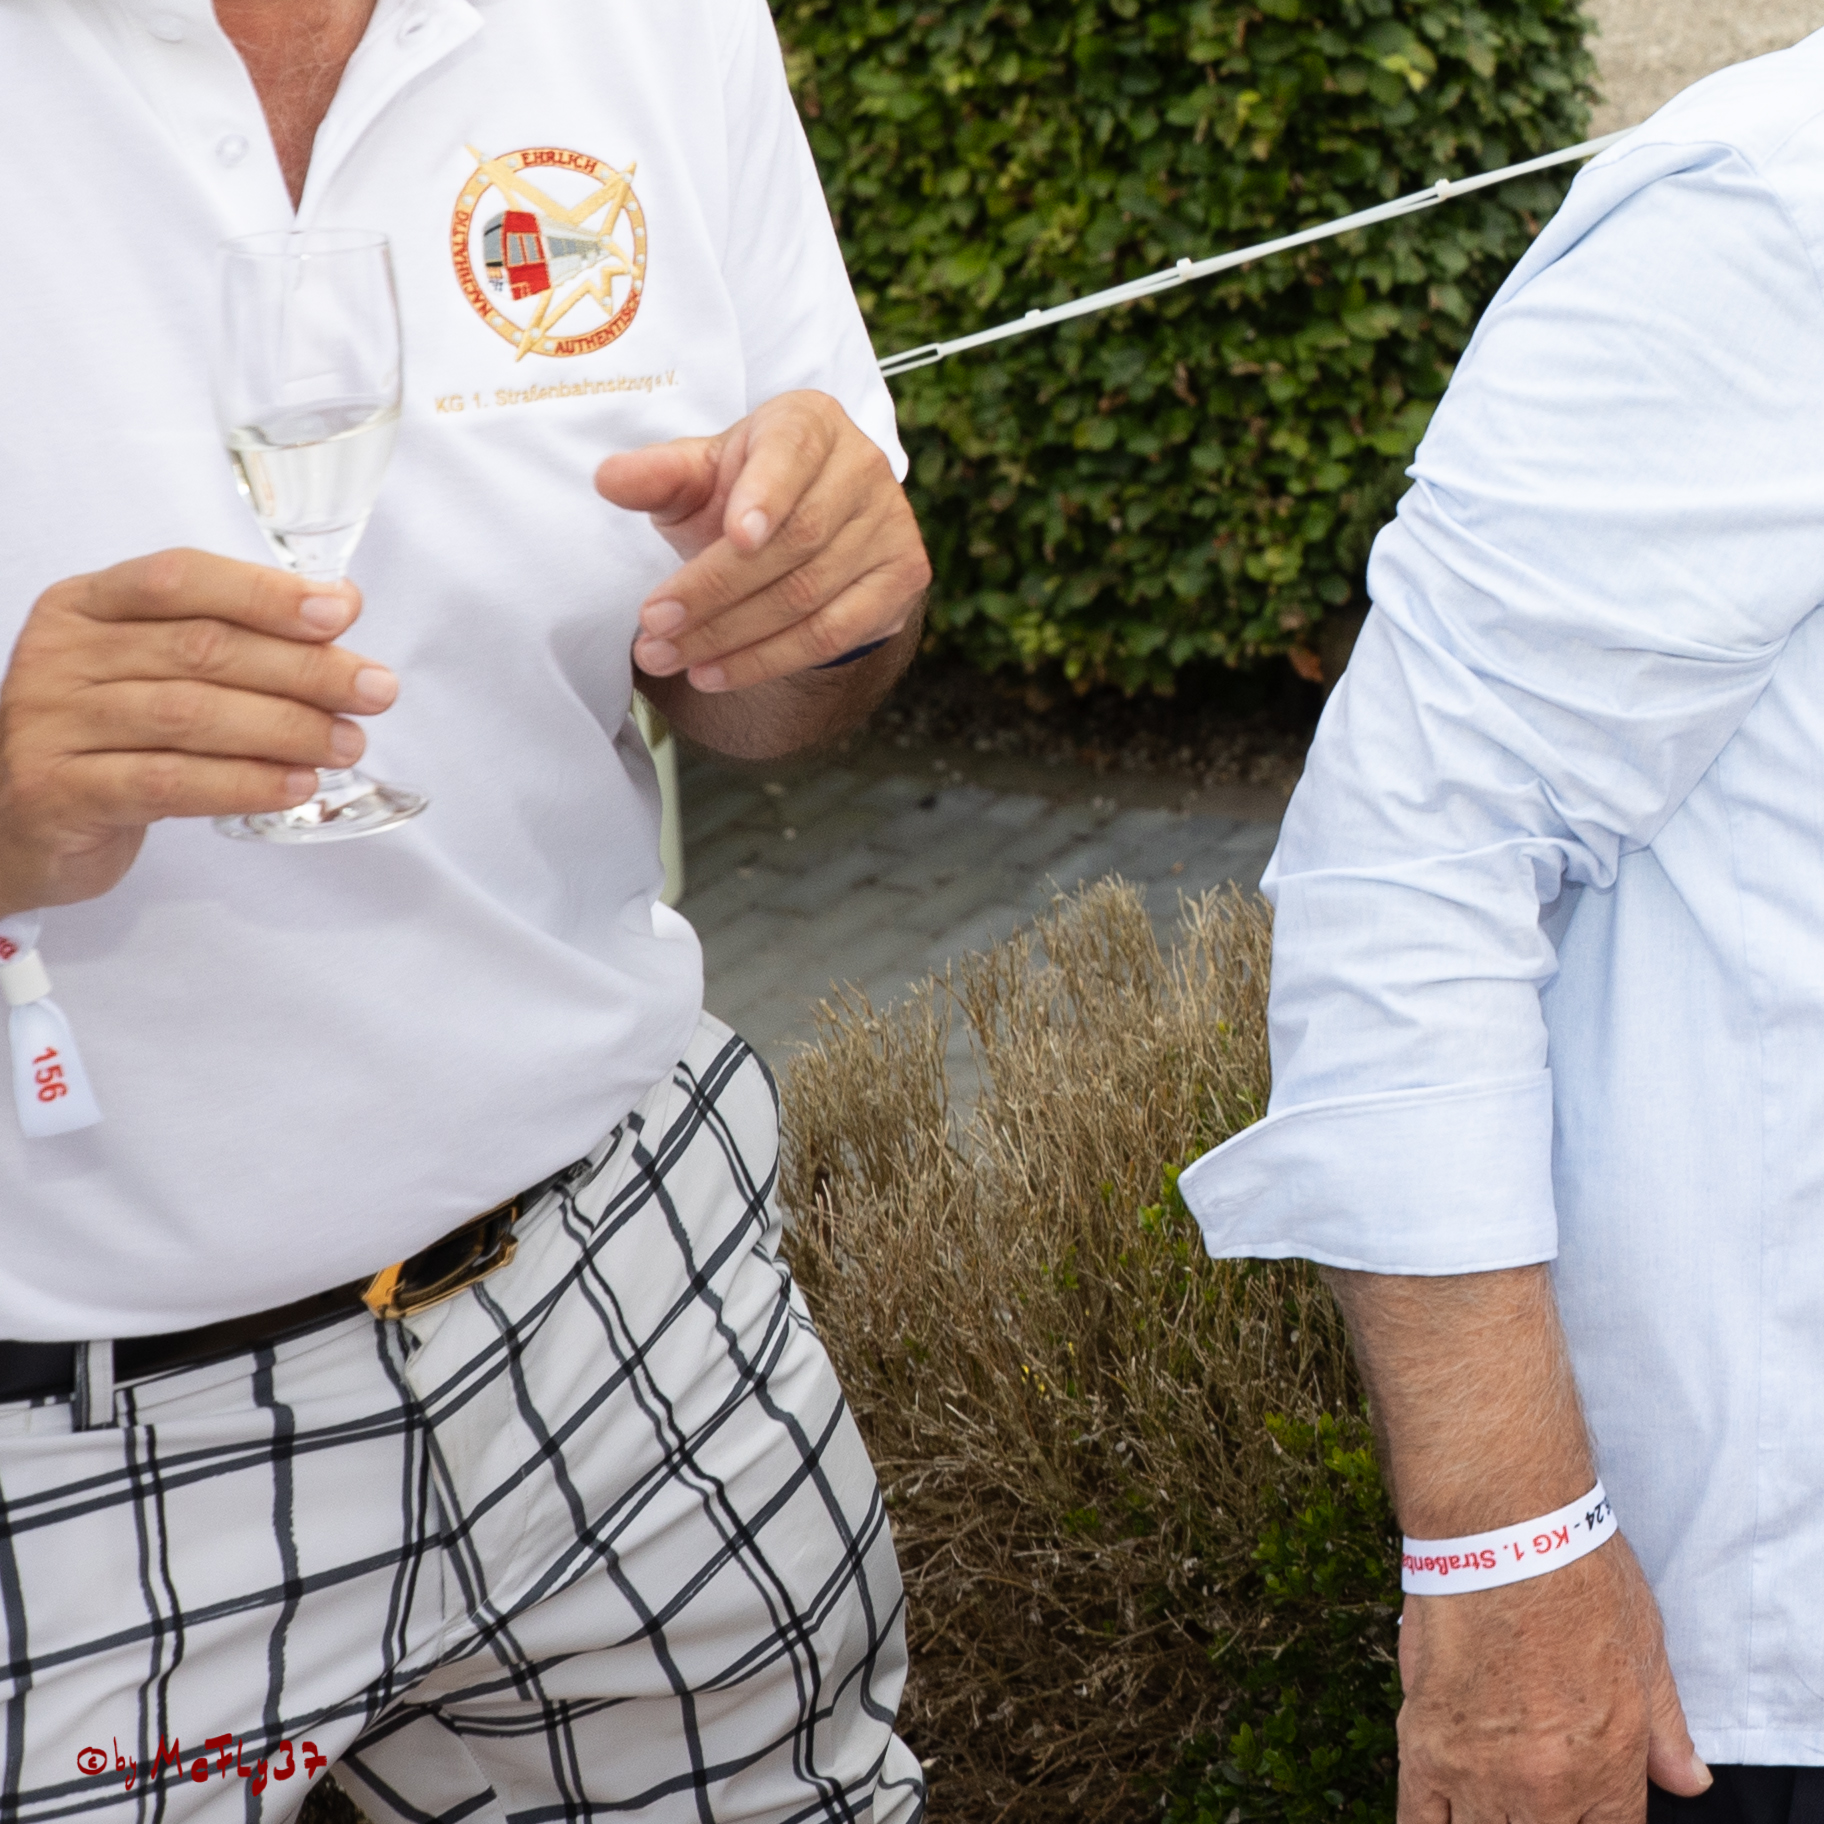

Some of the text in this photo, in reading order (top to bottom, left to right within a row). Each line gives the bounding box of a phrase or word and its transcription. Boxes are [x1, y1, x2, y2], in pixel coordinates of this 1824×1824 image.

[521, 150, 598, 174] EHRLICH
[452, 209, 494, 317] NACHHALTIG
[434, 393, 465, 414] KG
[472, 391, 489, 409] 1.
[32, 1046, 69, 1104] 156
[1503, 1542, 1526, 1562] 1.
[1531, 1525, 1570, 1555] KG
